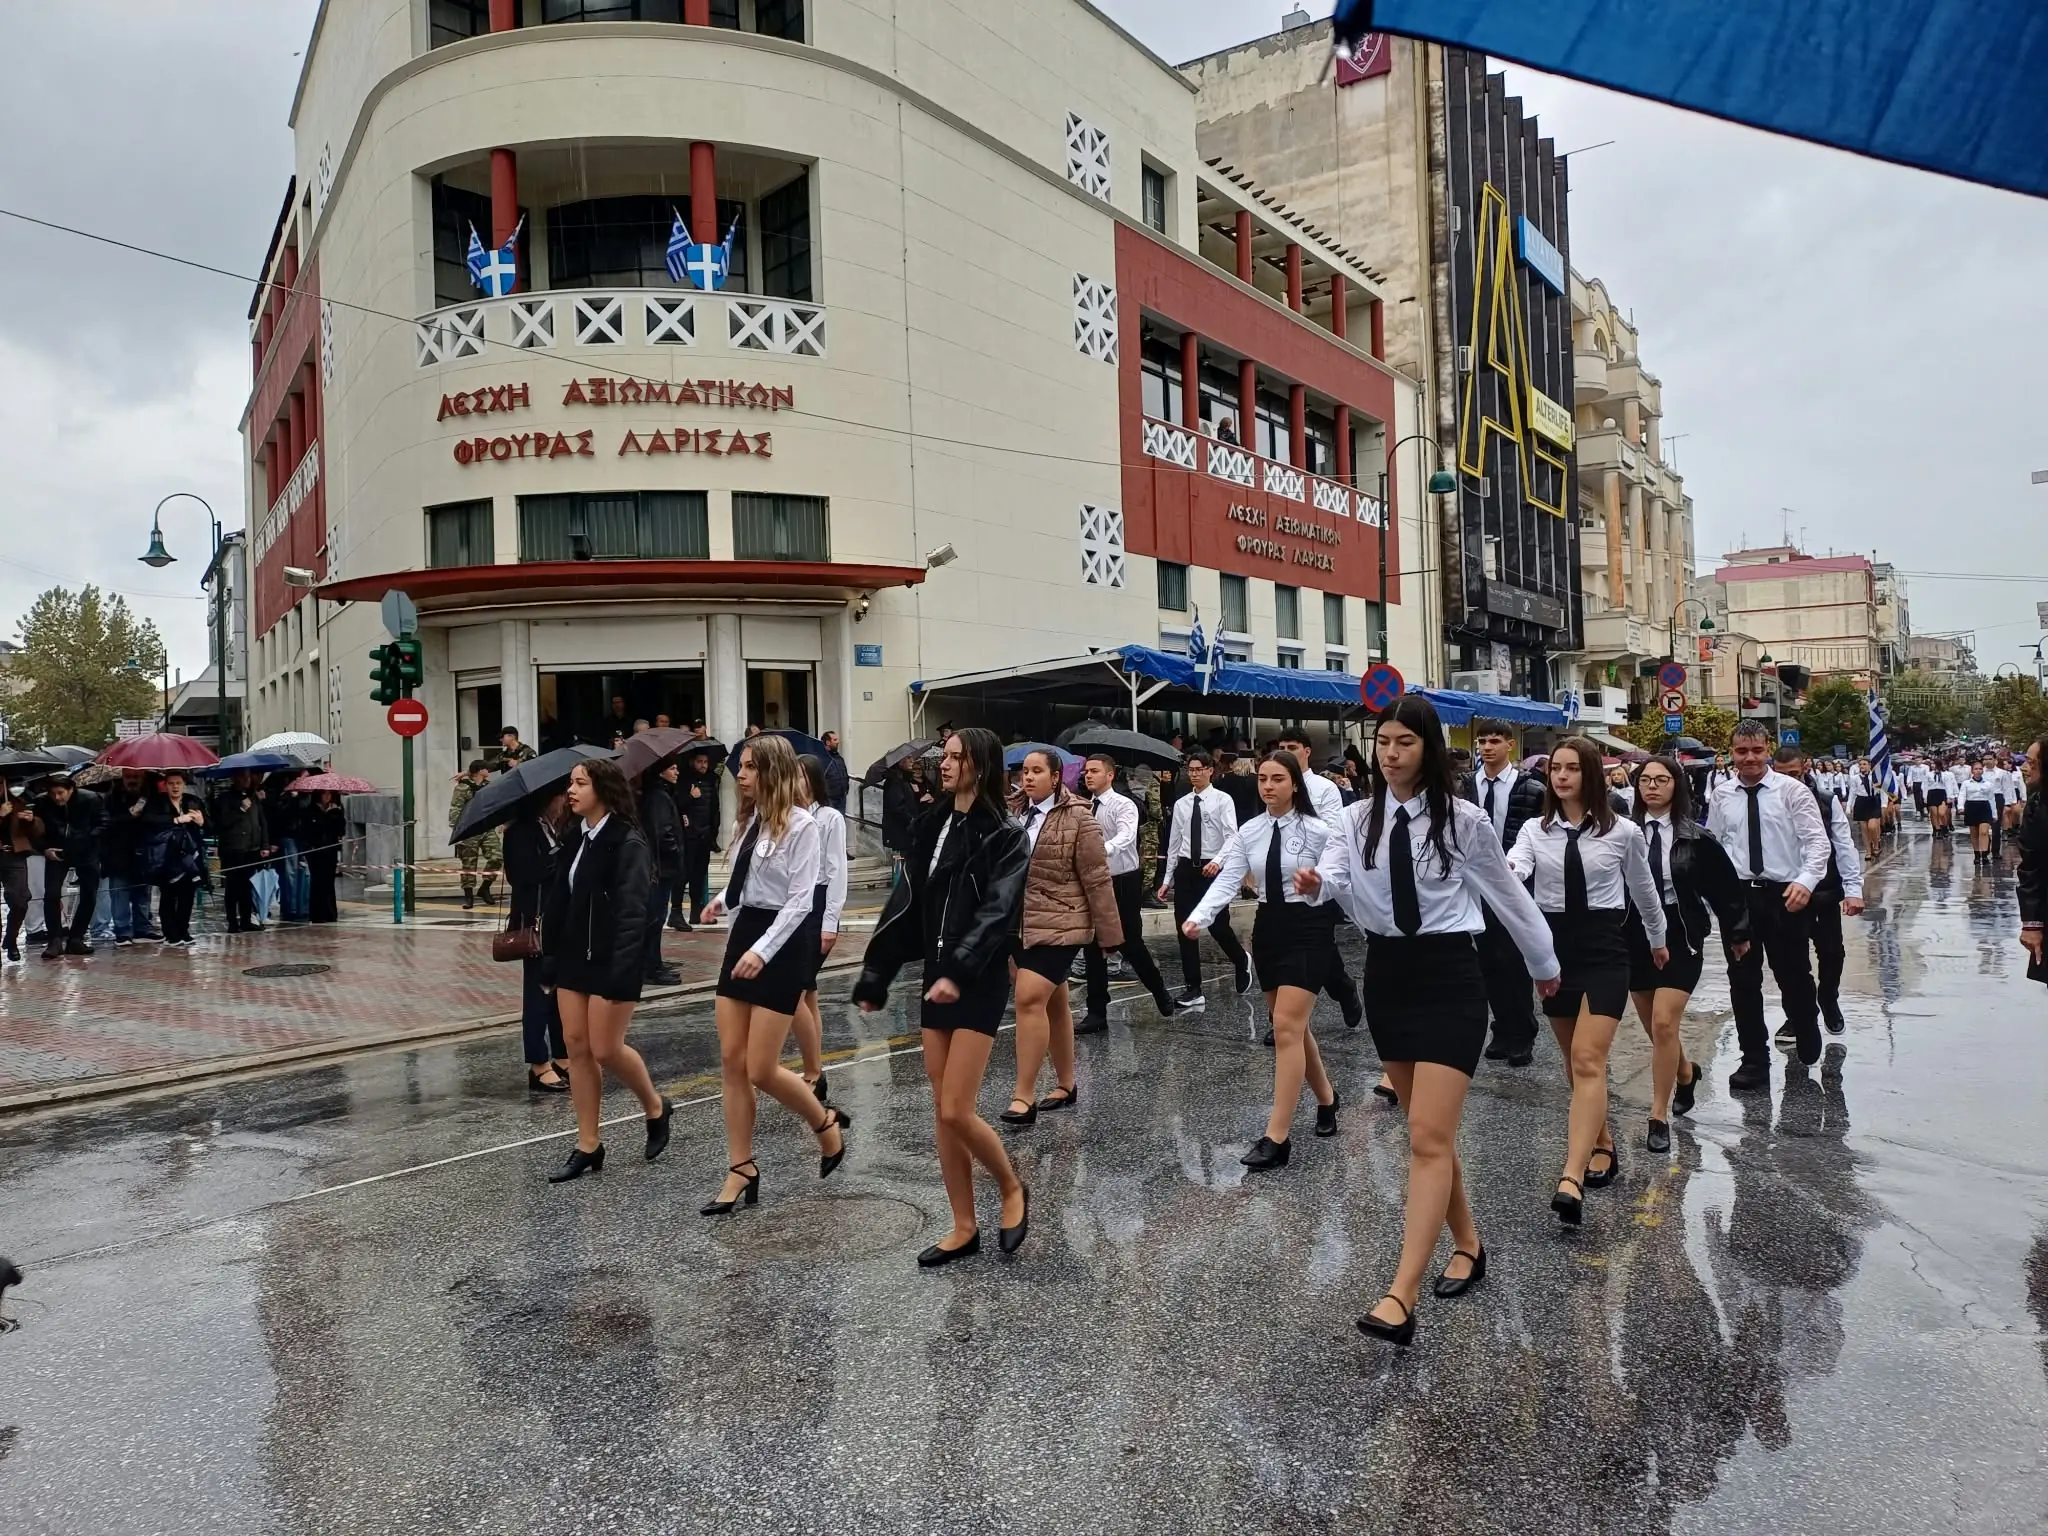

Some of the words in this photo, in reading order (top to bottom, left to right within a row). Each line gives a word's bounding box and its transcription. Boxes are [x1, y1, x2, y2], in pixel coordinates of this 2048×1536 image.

[437, 382, 530, 422] ΛΕΣΧΗ
[563, 377, 793, 411] ΑΞΙΩΜΑΤΙΚΩΝ
[1536, 397, 1568, 433] ALTERLIFE
[454, 429, 594, 464] ΦΡΟΥΡΑΣ
[619, 428, 772, 457] ΛΑΡΙΣΑΣ
[1228, 502, 1267, 527] ΛΕΣΧΗ
[1275, 515, 1341, 546] ΑΞΙΩΜΑΤΙΚΩΝ
[1237, 534, 1286, 561] ΦΡΟΥΡΑΣ
[1294, 549, 1335, 572] ΛΑΡΙΣΑΣ
